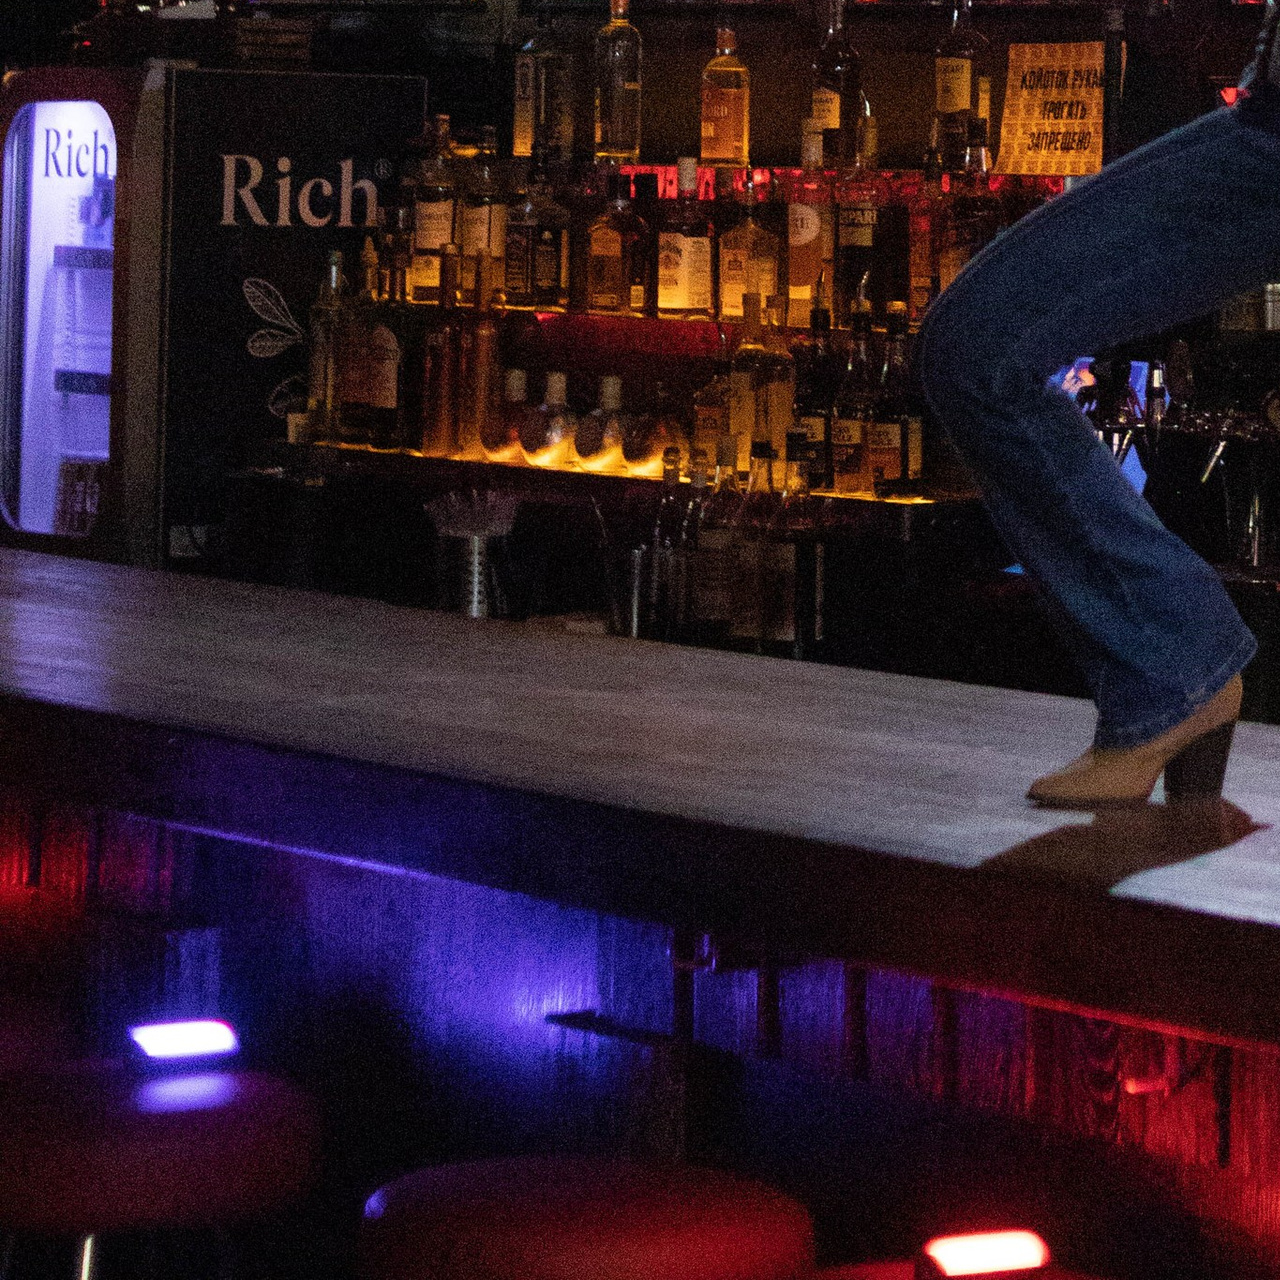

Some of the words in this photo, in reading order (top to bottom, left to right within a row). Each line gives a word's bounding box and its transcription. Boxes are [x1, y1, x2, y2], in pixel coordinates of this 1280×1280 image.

[1041, 100, 1088, 120] ТРОГАТЬ
[1026, 131, 1092, 152] ЗАПРЕЩЕНО
[43, 128, 111, 178] Rich
